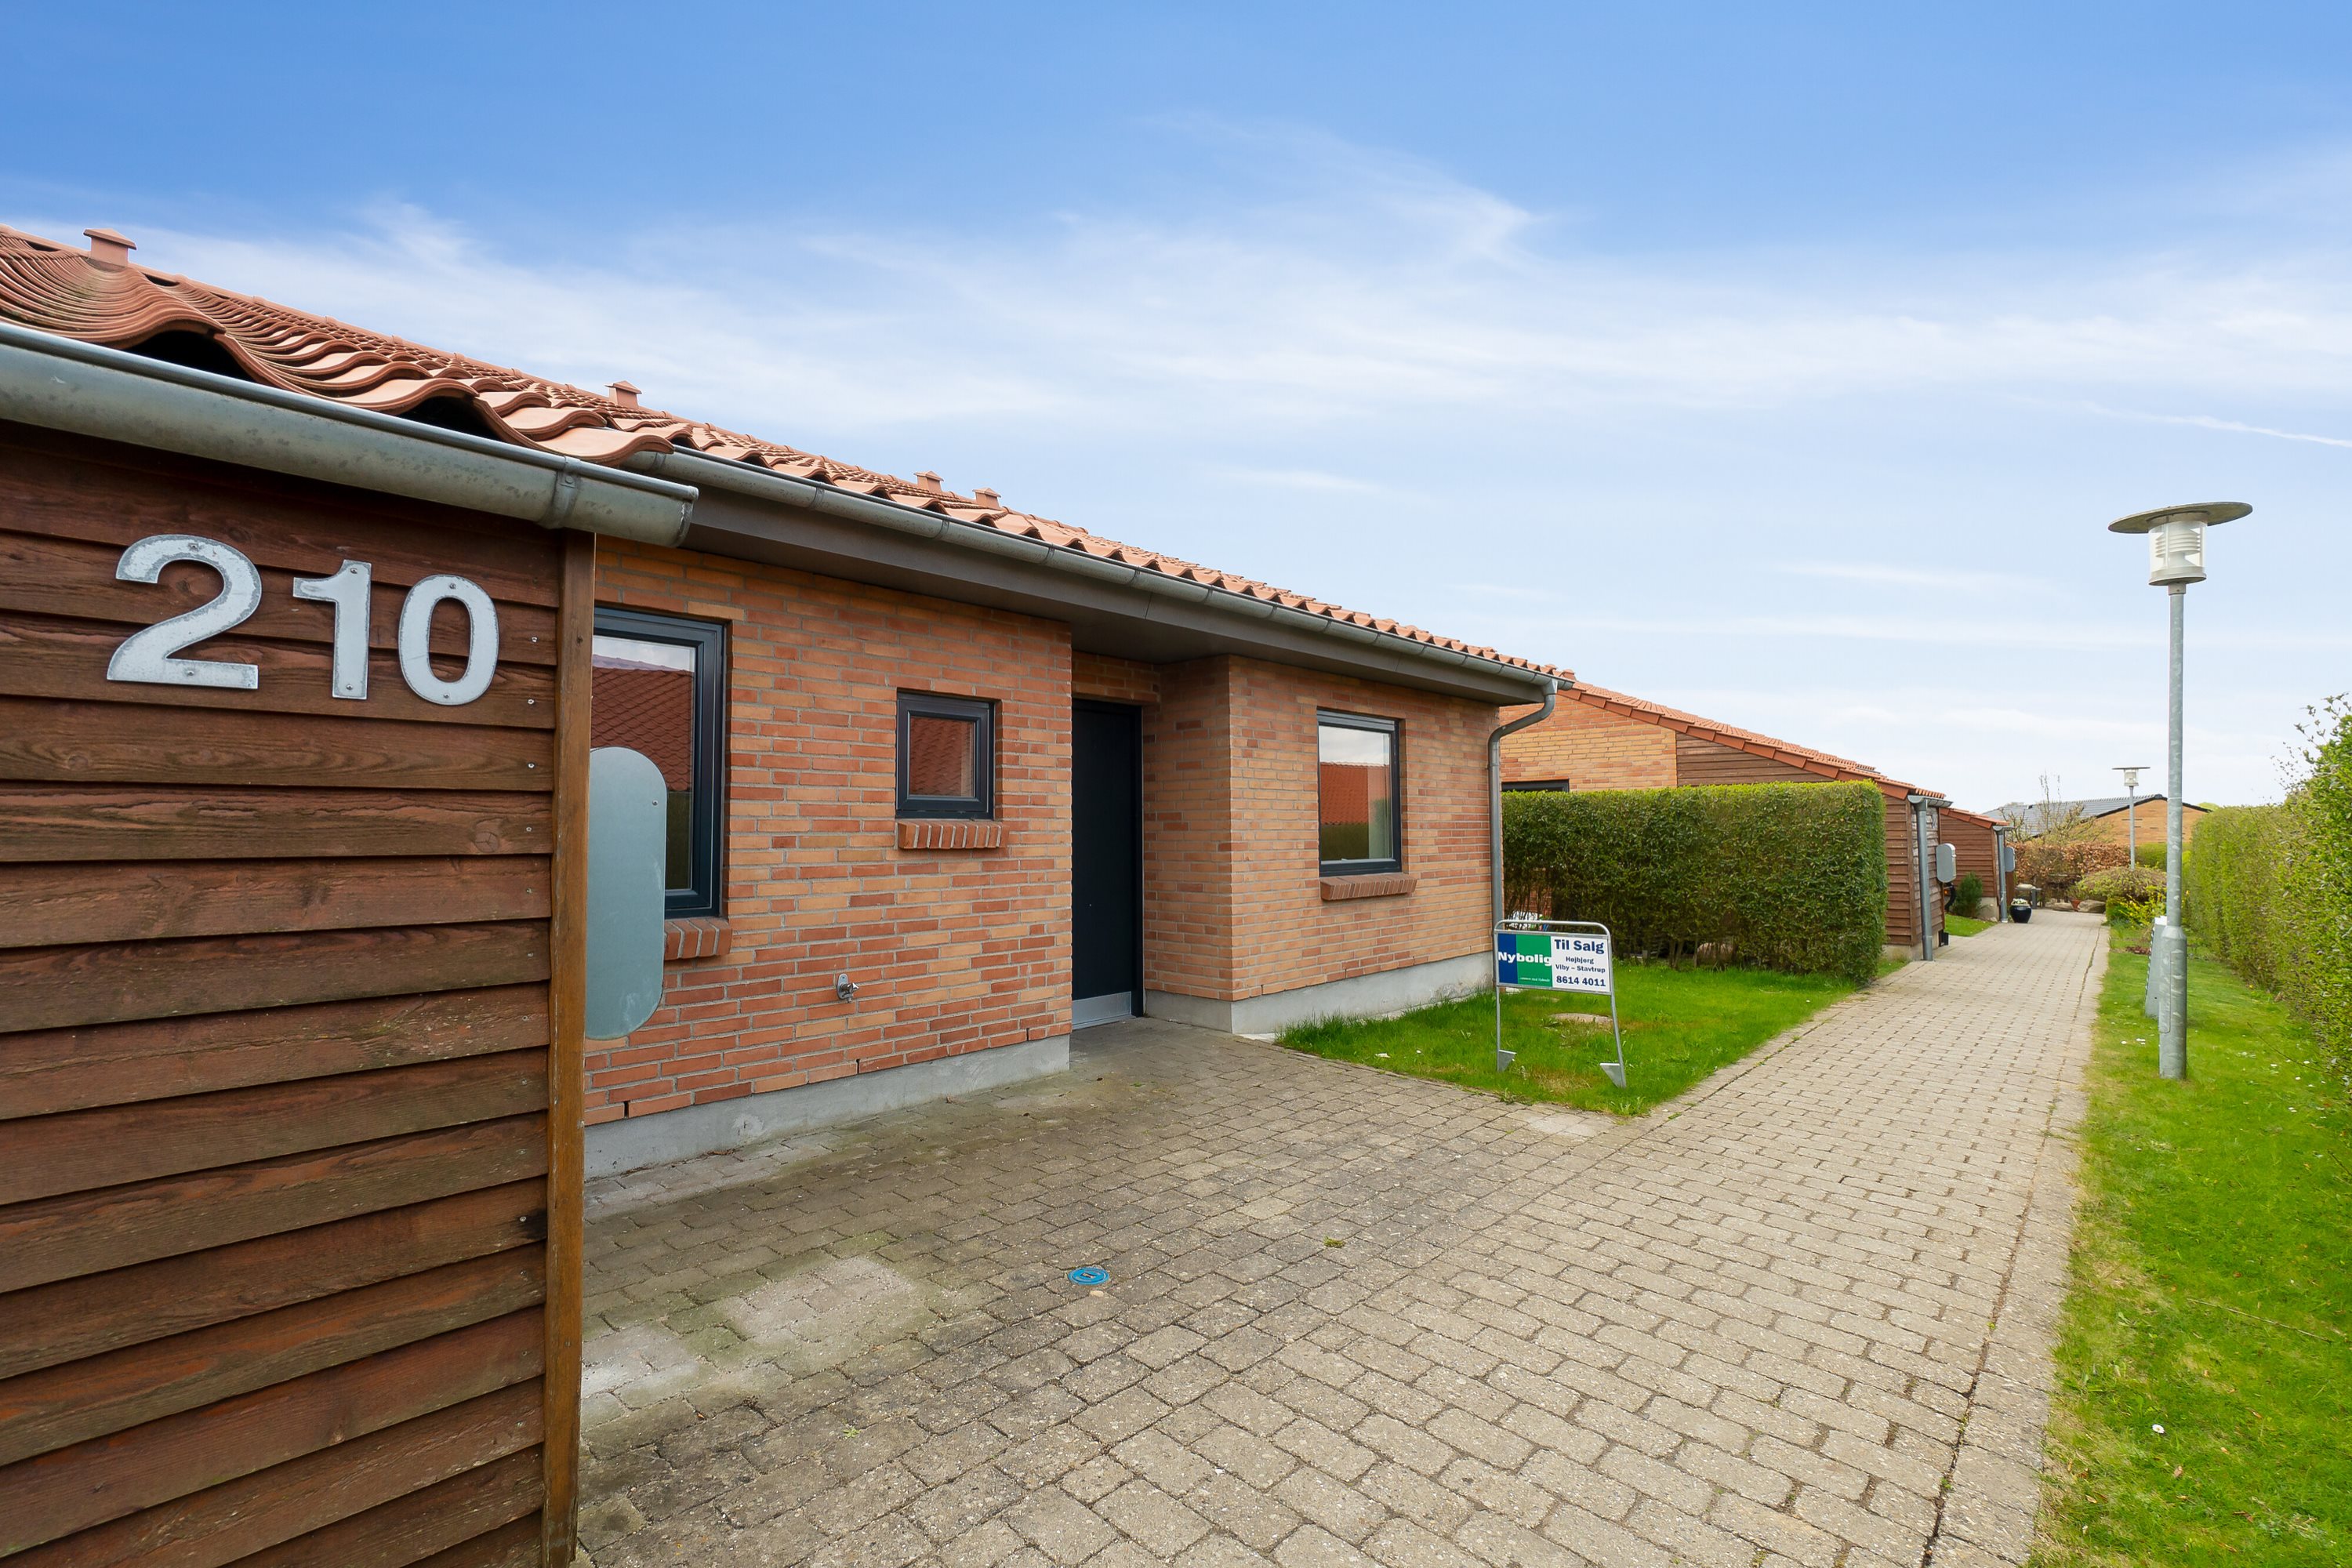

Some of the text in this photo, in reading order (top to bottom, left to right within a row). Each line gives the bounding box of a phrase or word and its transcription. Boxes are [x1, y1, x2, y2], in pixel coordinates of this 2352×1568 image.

[107, 533, 499, 706] 210
[1554, 939, 1605, 954] Til Salg
[1498, 952, 1552, 967] Nybolig
[1556, 975, 1580, 985] 8614
[1582, 978, 1606, 986] 4011
